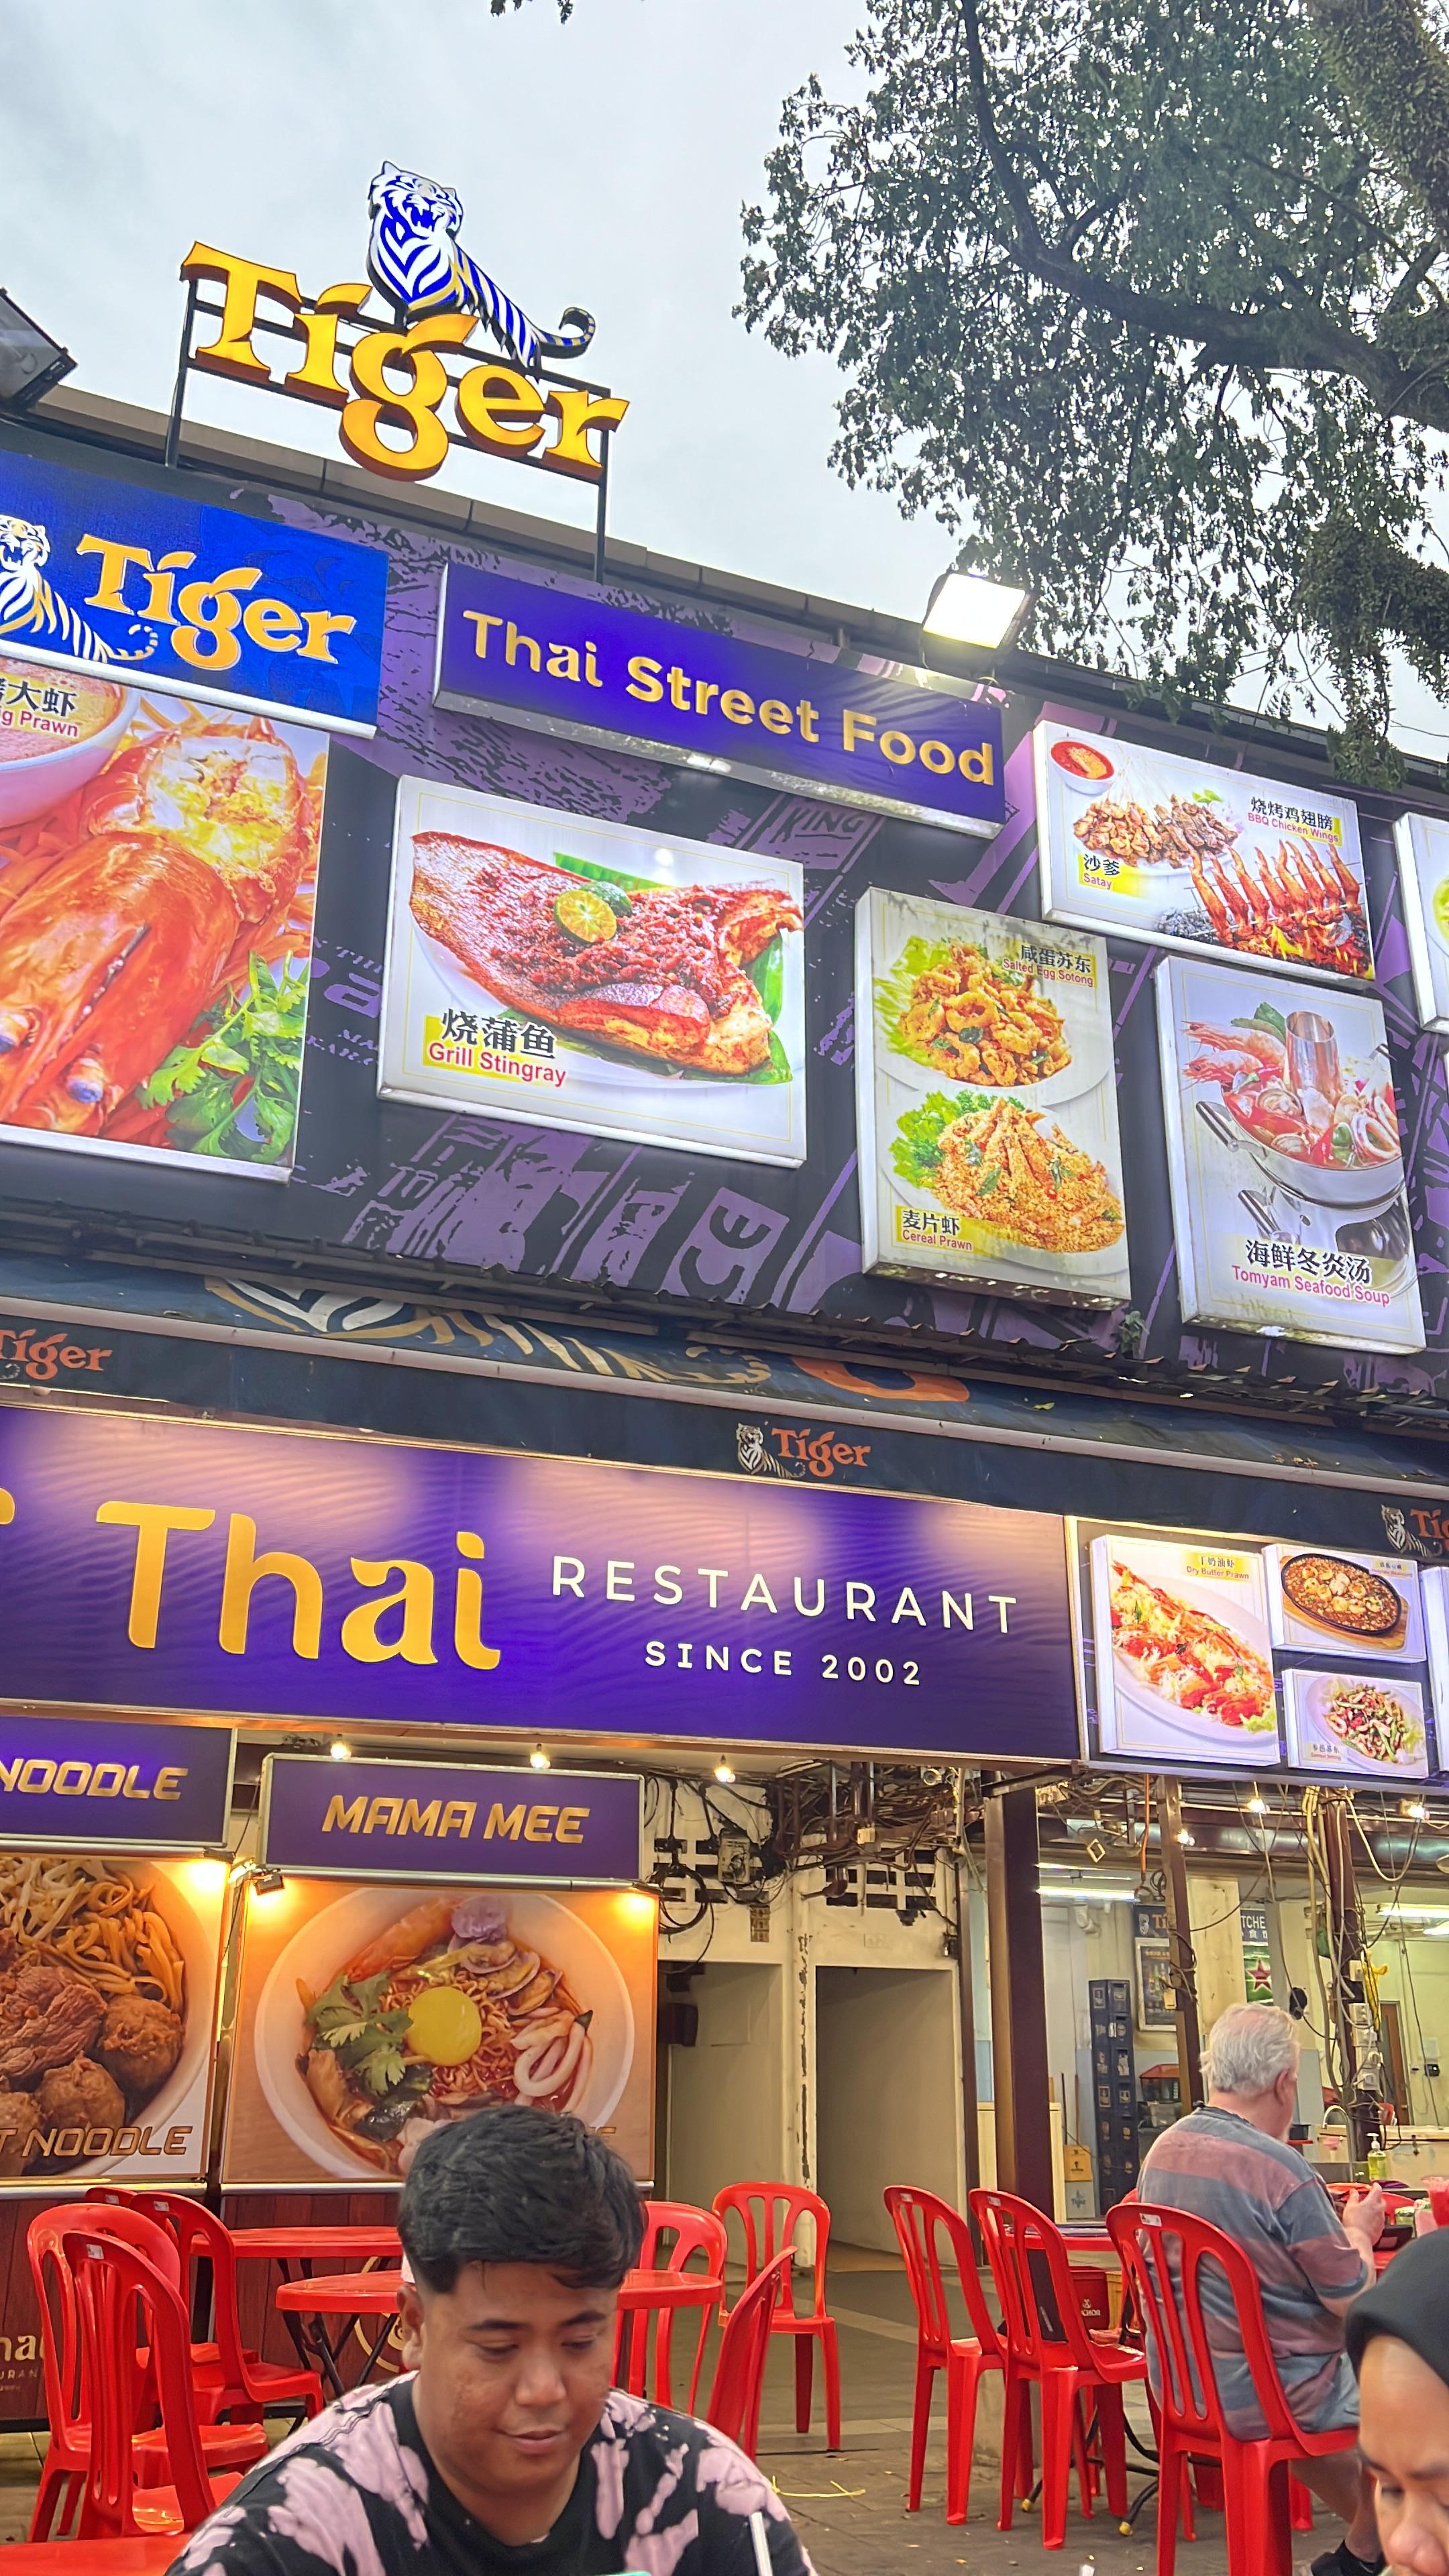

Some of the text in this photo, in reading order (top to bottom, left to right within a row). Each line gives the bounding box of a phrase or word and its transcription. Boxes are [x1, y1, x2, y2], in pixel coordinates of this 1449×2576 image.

[181, 240, 630, 482] Tiger
[76, 534, 357, 671] Tiger
[0, 677, 77, 717] 大虾
[463, 610, 995, 786] Thai Street Food
[20, 710, 78, 737] Prawn
[1248, 812, 1339, 843] BBQ Chicken Wings
[1083, 854, 1120, 875] 沙爹
[1083, 873, 1112, 890] Satay
[1003, 958, 1093, 988] Salted Egg Sotong
[1021, 945, 1091, 973] 咸蛋苏东
[441, 1008, 555, 1059] 烧蒲鱼
[429, 1042, 566, 1087] Grill Stingray
[902, 1210, 961, 1236] 麦片虾
[902, 1229, 973, 1251] Cereal Prawn
[1245, 1240, 1371, 1285] 海鲜冬炎汤
[1232, 1265, 1391, 1307] Tomyam Seafood Soup
[771, 1428, 871, 1477] Tiger
[95, 1501, 501, 1670] Thai
[1187, 1566, 1250, 1579] Dry Butter Prawn
[551, 1555, 1017, 1633] RESTAURANT
[645, 1640, 920, 1686] SINCE 2002
[0, 1758, 189, 1801] NOODLE
[321, 1794, 591, 1844] MAMA MEE
[1240, 1915, 1267, 1929] TCHE
[21, 2126, 193, 2157] NOODLE
